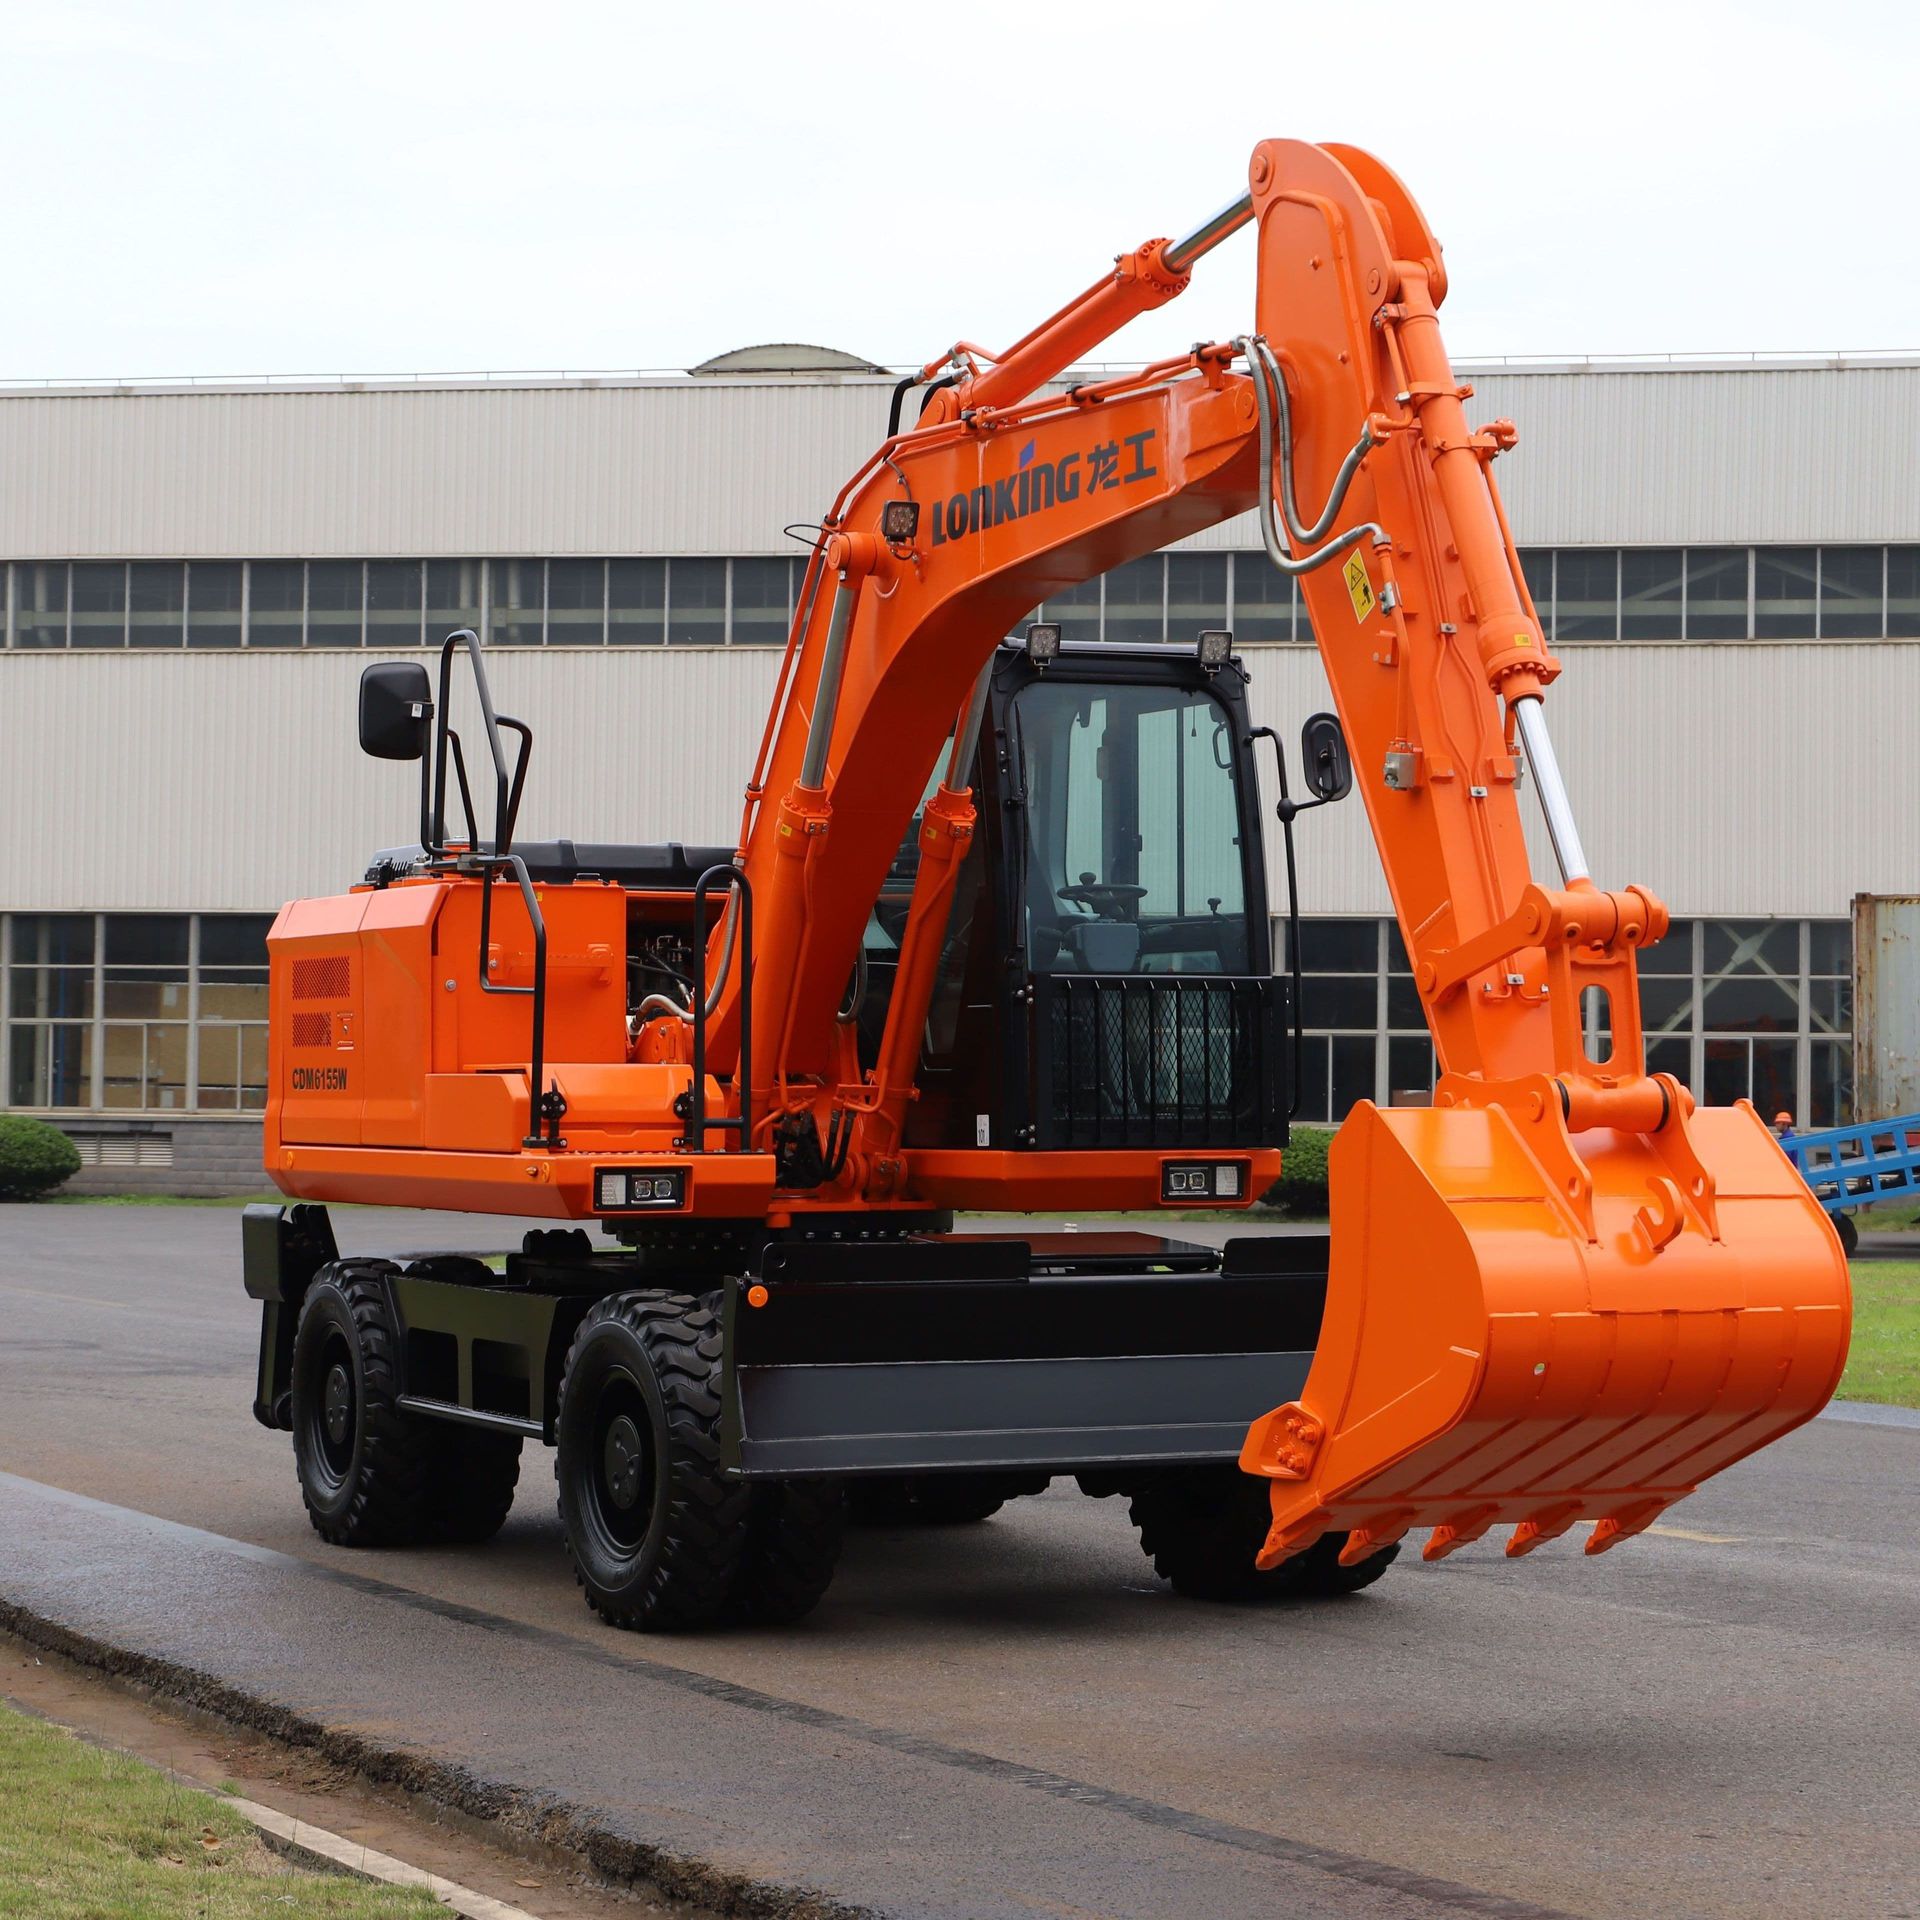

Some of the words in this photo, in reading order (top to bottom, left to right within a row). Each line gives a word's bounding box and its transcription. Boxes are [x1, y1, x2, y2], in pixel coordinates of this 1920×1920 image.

[932, 438, 1080, 547] LONKING
[1087, 428, 1157, 495] 龙工
[292, 1067, 348, 1090] CDM6155W
